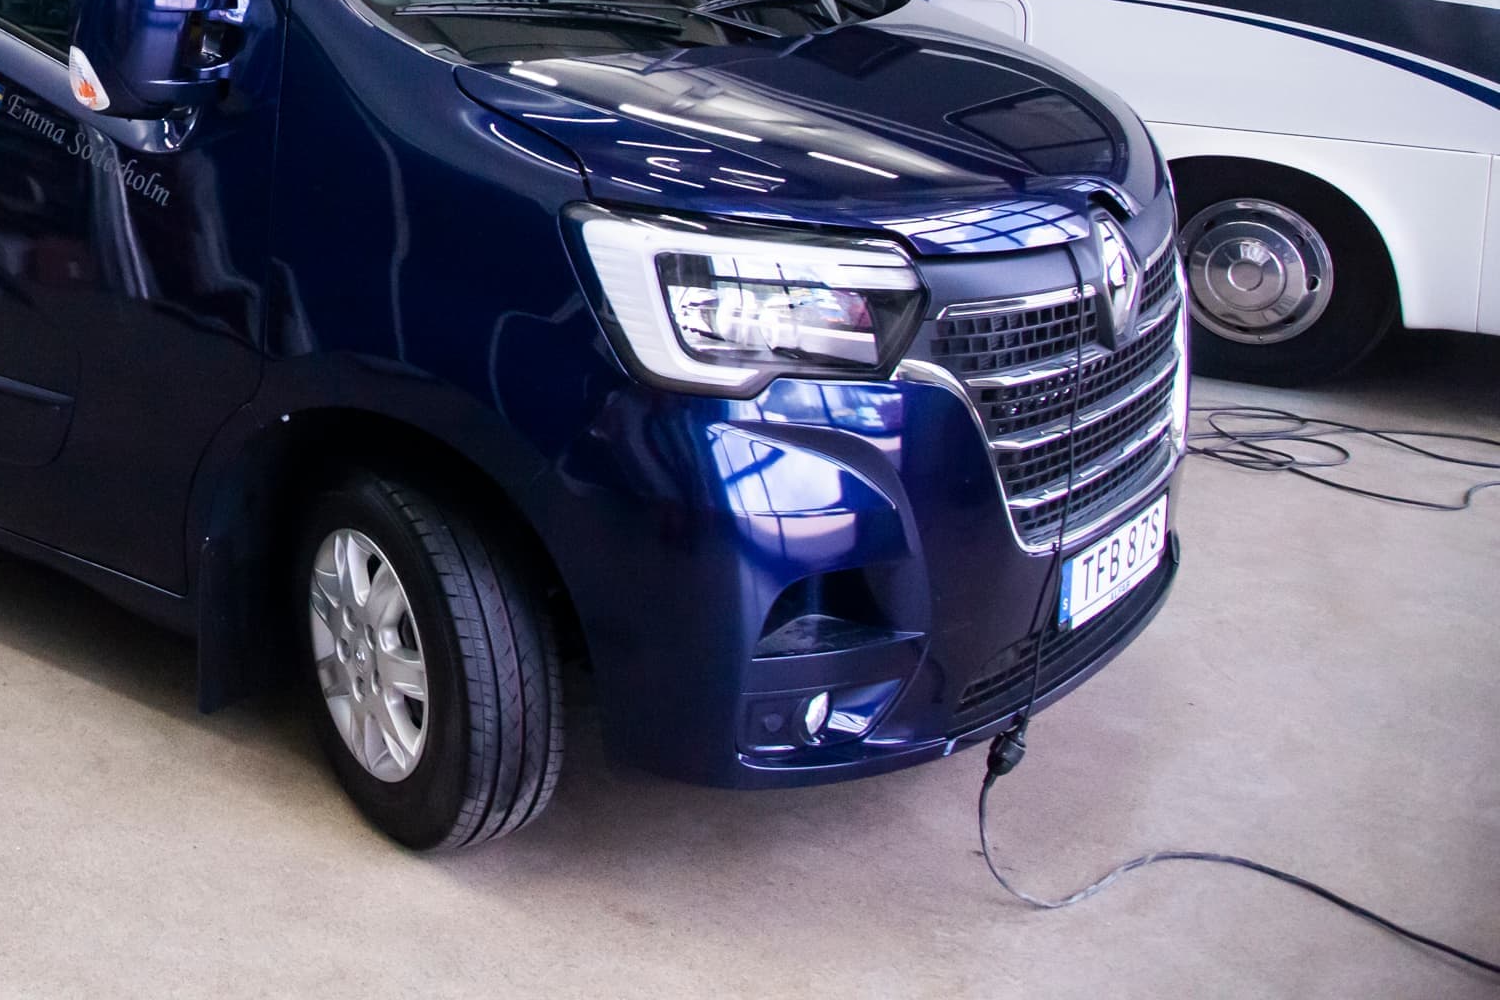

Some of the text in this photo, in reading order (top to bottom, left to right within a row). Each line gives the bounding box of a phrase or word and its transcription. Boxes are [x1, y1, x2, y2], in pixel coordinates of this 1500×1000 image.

[7, 94, 67, 145] Emma
[1082, 506, 1160, 601] TFB 87S
